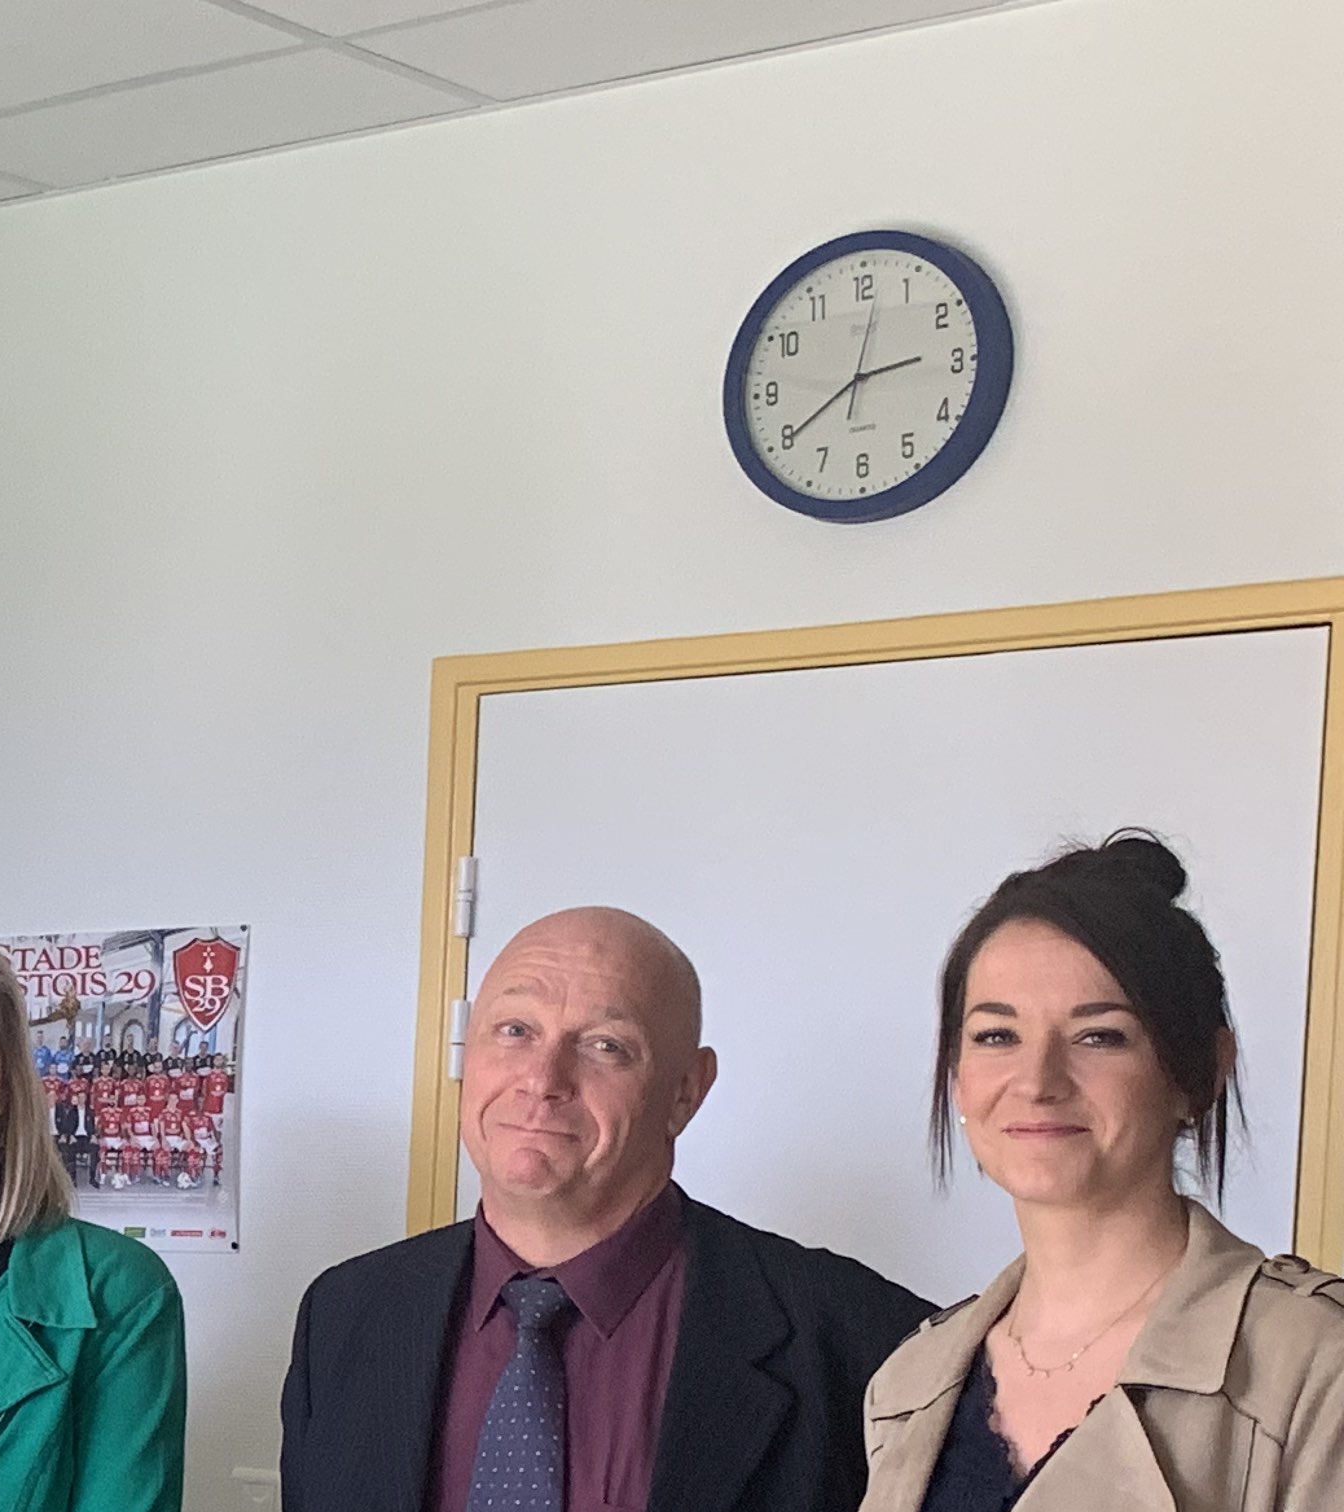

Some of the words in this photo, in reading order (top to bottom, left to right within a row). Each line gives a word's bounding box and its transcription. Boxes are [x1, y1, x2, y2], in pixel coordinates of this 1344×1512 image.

[852, 274, 875, 302] 12
[809, 295, 826, 322] 11
[935, 302, 950, 330] 2
[778, 331, 800, 359] 10
[950, 347, 965, 375] 3
[765, 381, 779, 407] 9
[935, 396, 950, 423] 4
[780, 424, 795, 451] 8
[901, 432, 915, 460] 5
[816, 446, 830, 473] 7
[855, 452, 870, 479] 6
[115, 969, 156, 1001] 29
[184, 975, 229, 998] SB
[192, 996, 221, 1017] 29
